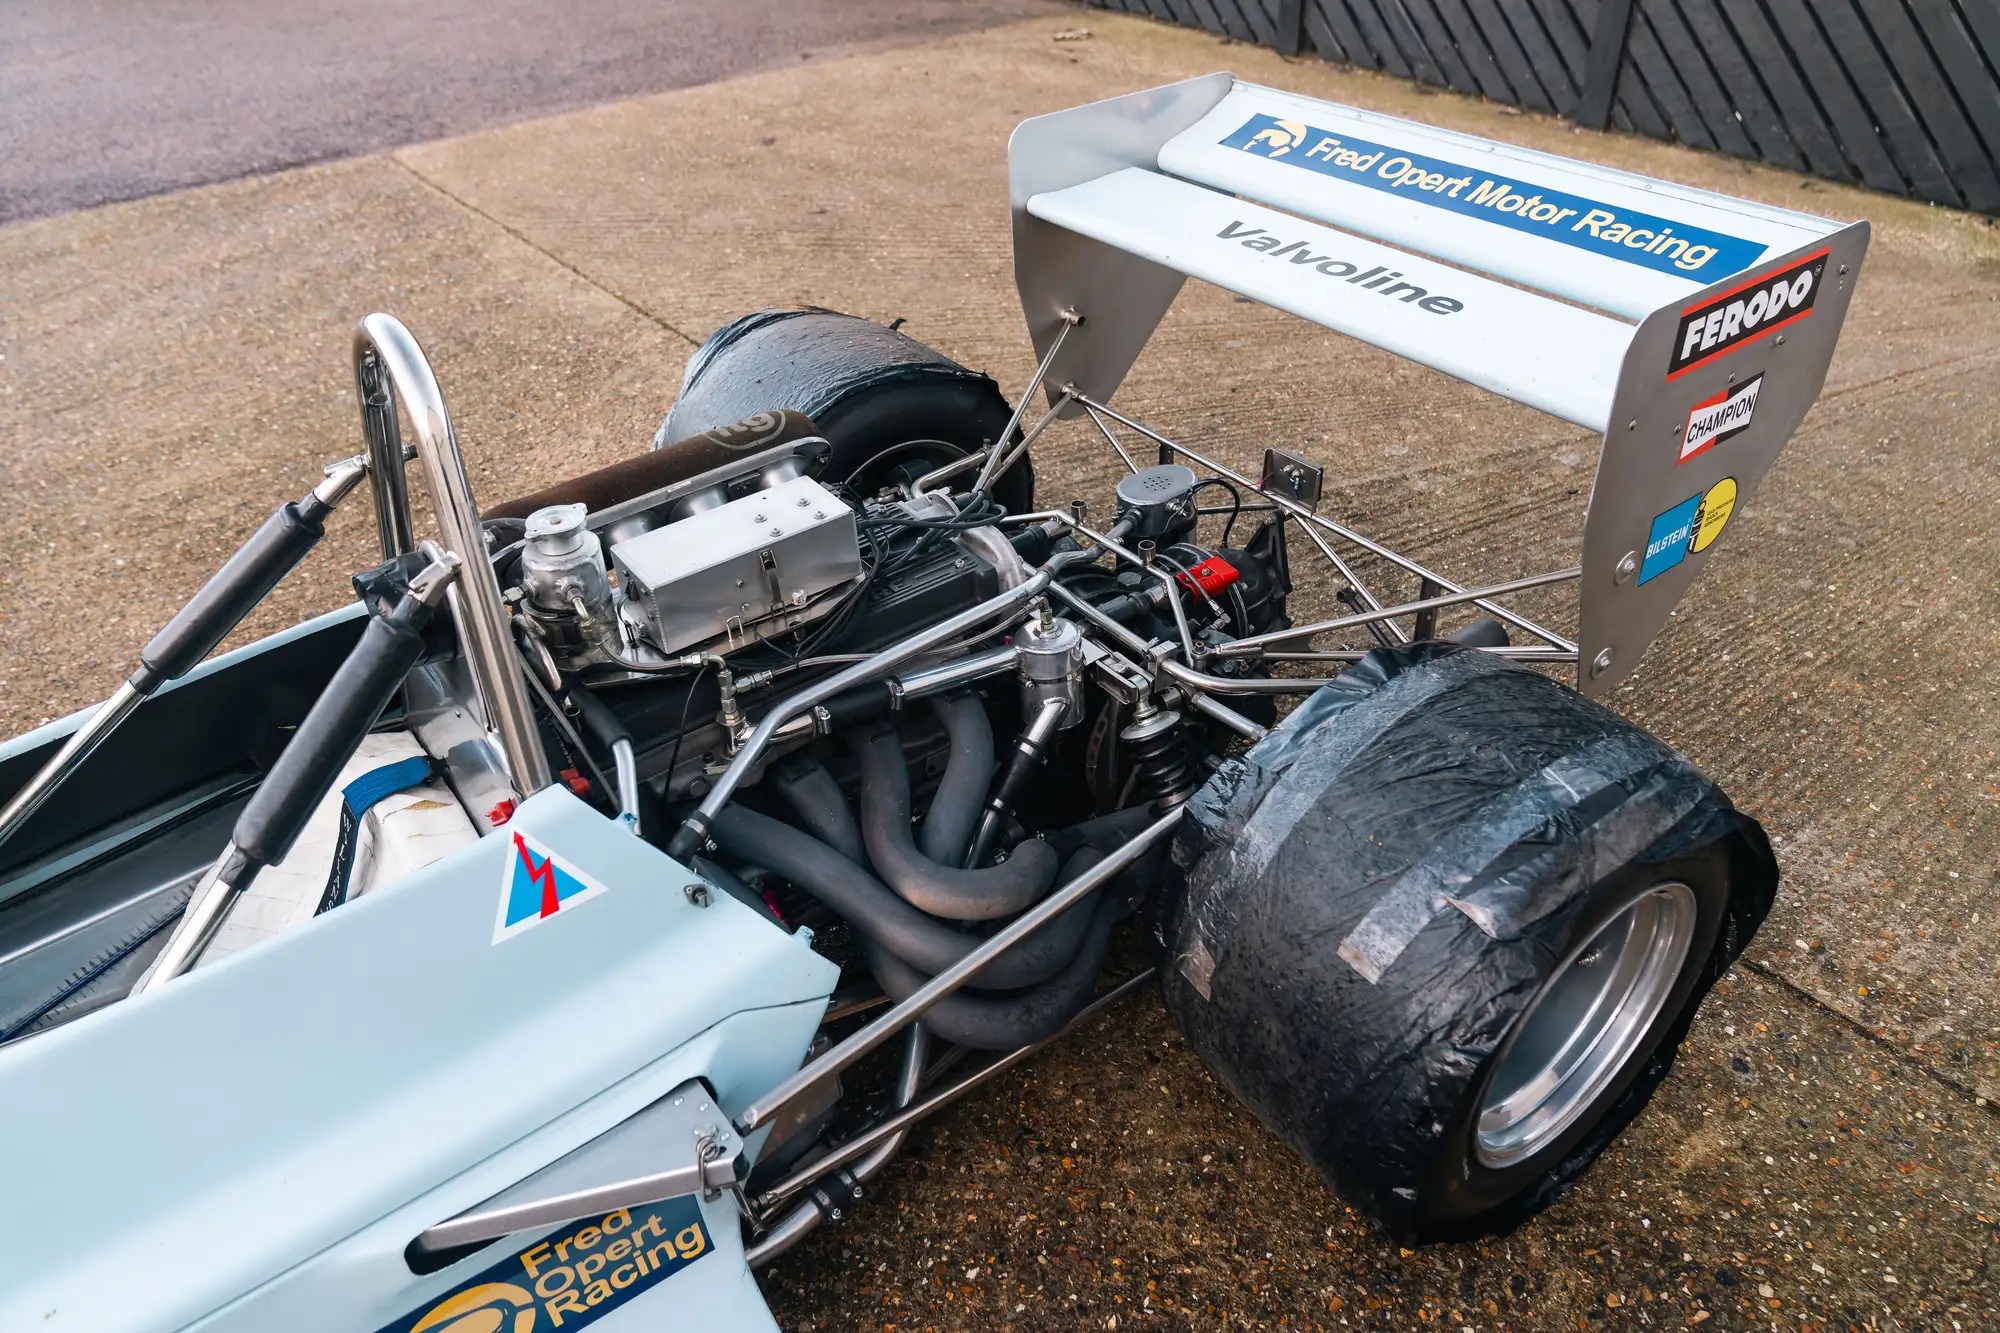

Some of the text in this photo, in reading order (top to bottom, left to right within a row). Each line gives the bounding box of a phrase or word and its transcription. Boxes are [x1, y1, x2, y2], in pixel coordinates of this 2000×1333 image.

[1305, 136, 1718, 270] Fred Opert Motor Racing
[1215, 220, 1465, 316] Valvoline
[1680, 269, 1813, 361] FERODO
[1687, 393, 1756, 443] CHAMPION
[1645, 523, 1689, 559] BILSTEIN
[519, 1207, 633, 1280] Fred
[534, 1213, 667, 1299] Opert
[544, 1223, 706, 1328] Racing
